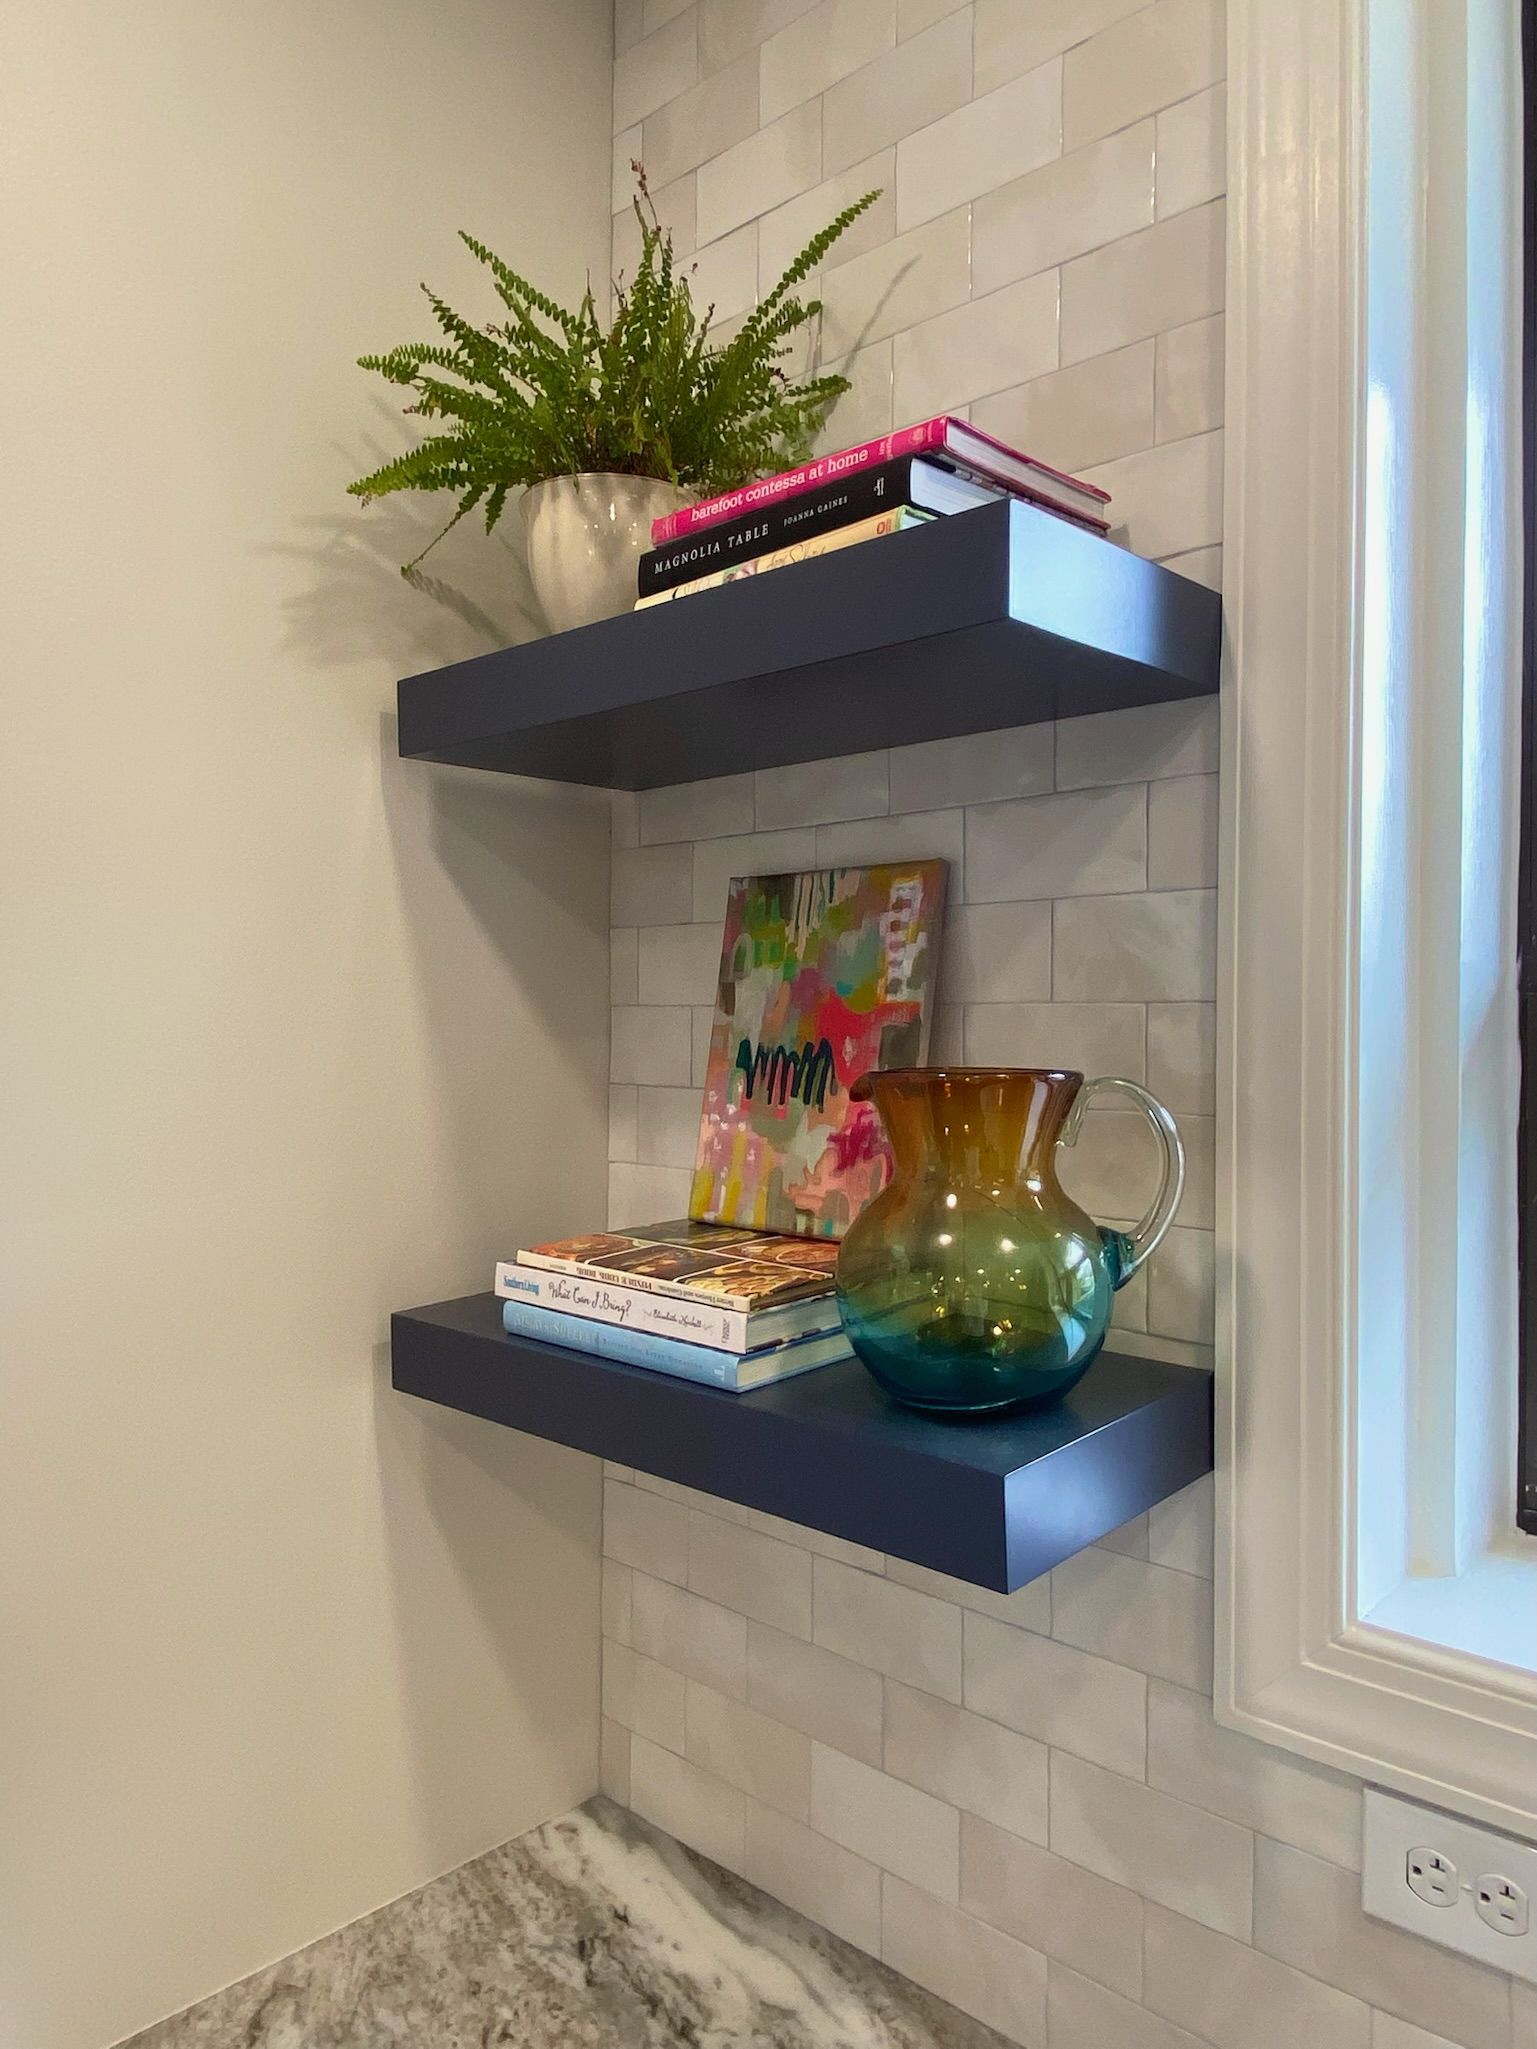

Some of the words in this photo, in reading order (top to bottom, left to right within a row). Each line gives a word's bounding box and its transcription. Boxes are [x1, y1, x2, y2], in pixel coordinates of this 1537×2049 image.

[691, 492, 743, 521] barefoot
[745, 470, 805, 502] contessa
[808, 464, 824, 480] at
[827, 448, 869, 474] home
[654, 541, 721, 575] MAGNOLIA
[728, 523, 769, 549] TABLE
[783, 508, 815, 527] JOANNA
[817, 495, 848, 514] GAINES
[548, 1280, 571, 1299] What
[573, 1286, 590, 1304] Can
[591, 1291, 600, 1309] I
[600, 1292, 633, 1322] Bring?
